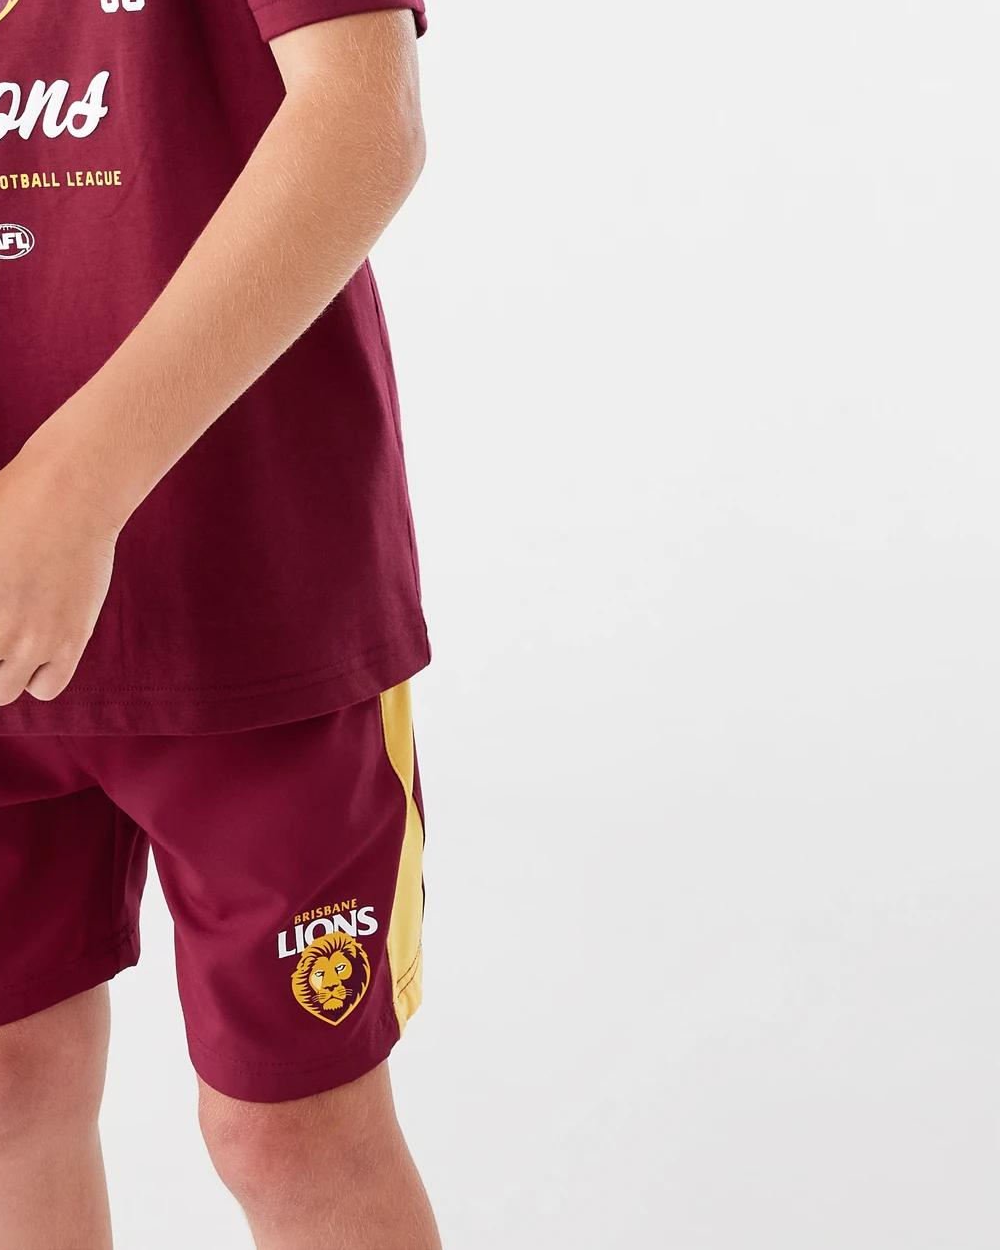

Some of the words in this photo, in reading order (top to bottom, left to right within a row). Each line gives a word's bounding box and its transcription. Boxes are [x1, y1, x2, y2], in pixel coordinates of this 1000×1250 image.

[66, 170, 122, 188] LEAGUE
[294, 898, 358, 925] BRISBANE
[278, 906, 379, 959] LIONS
